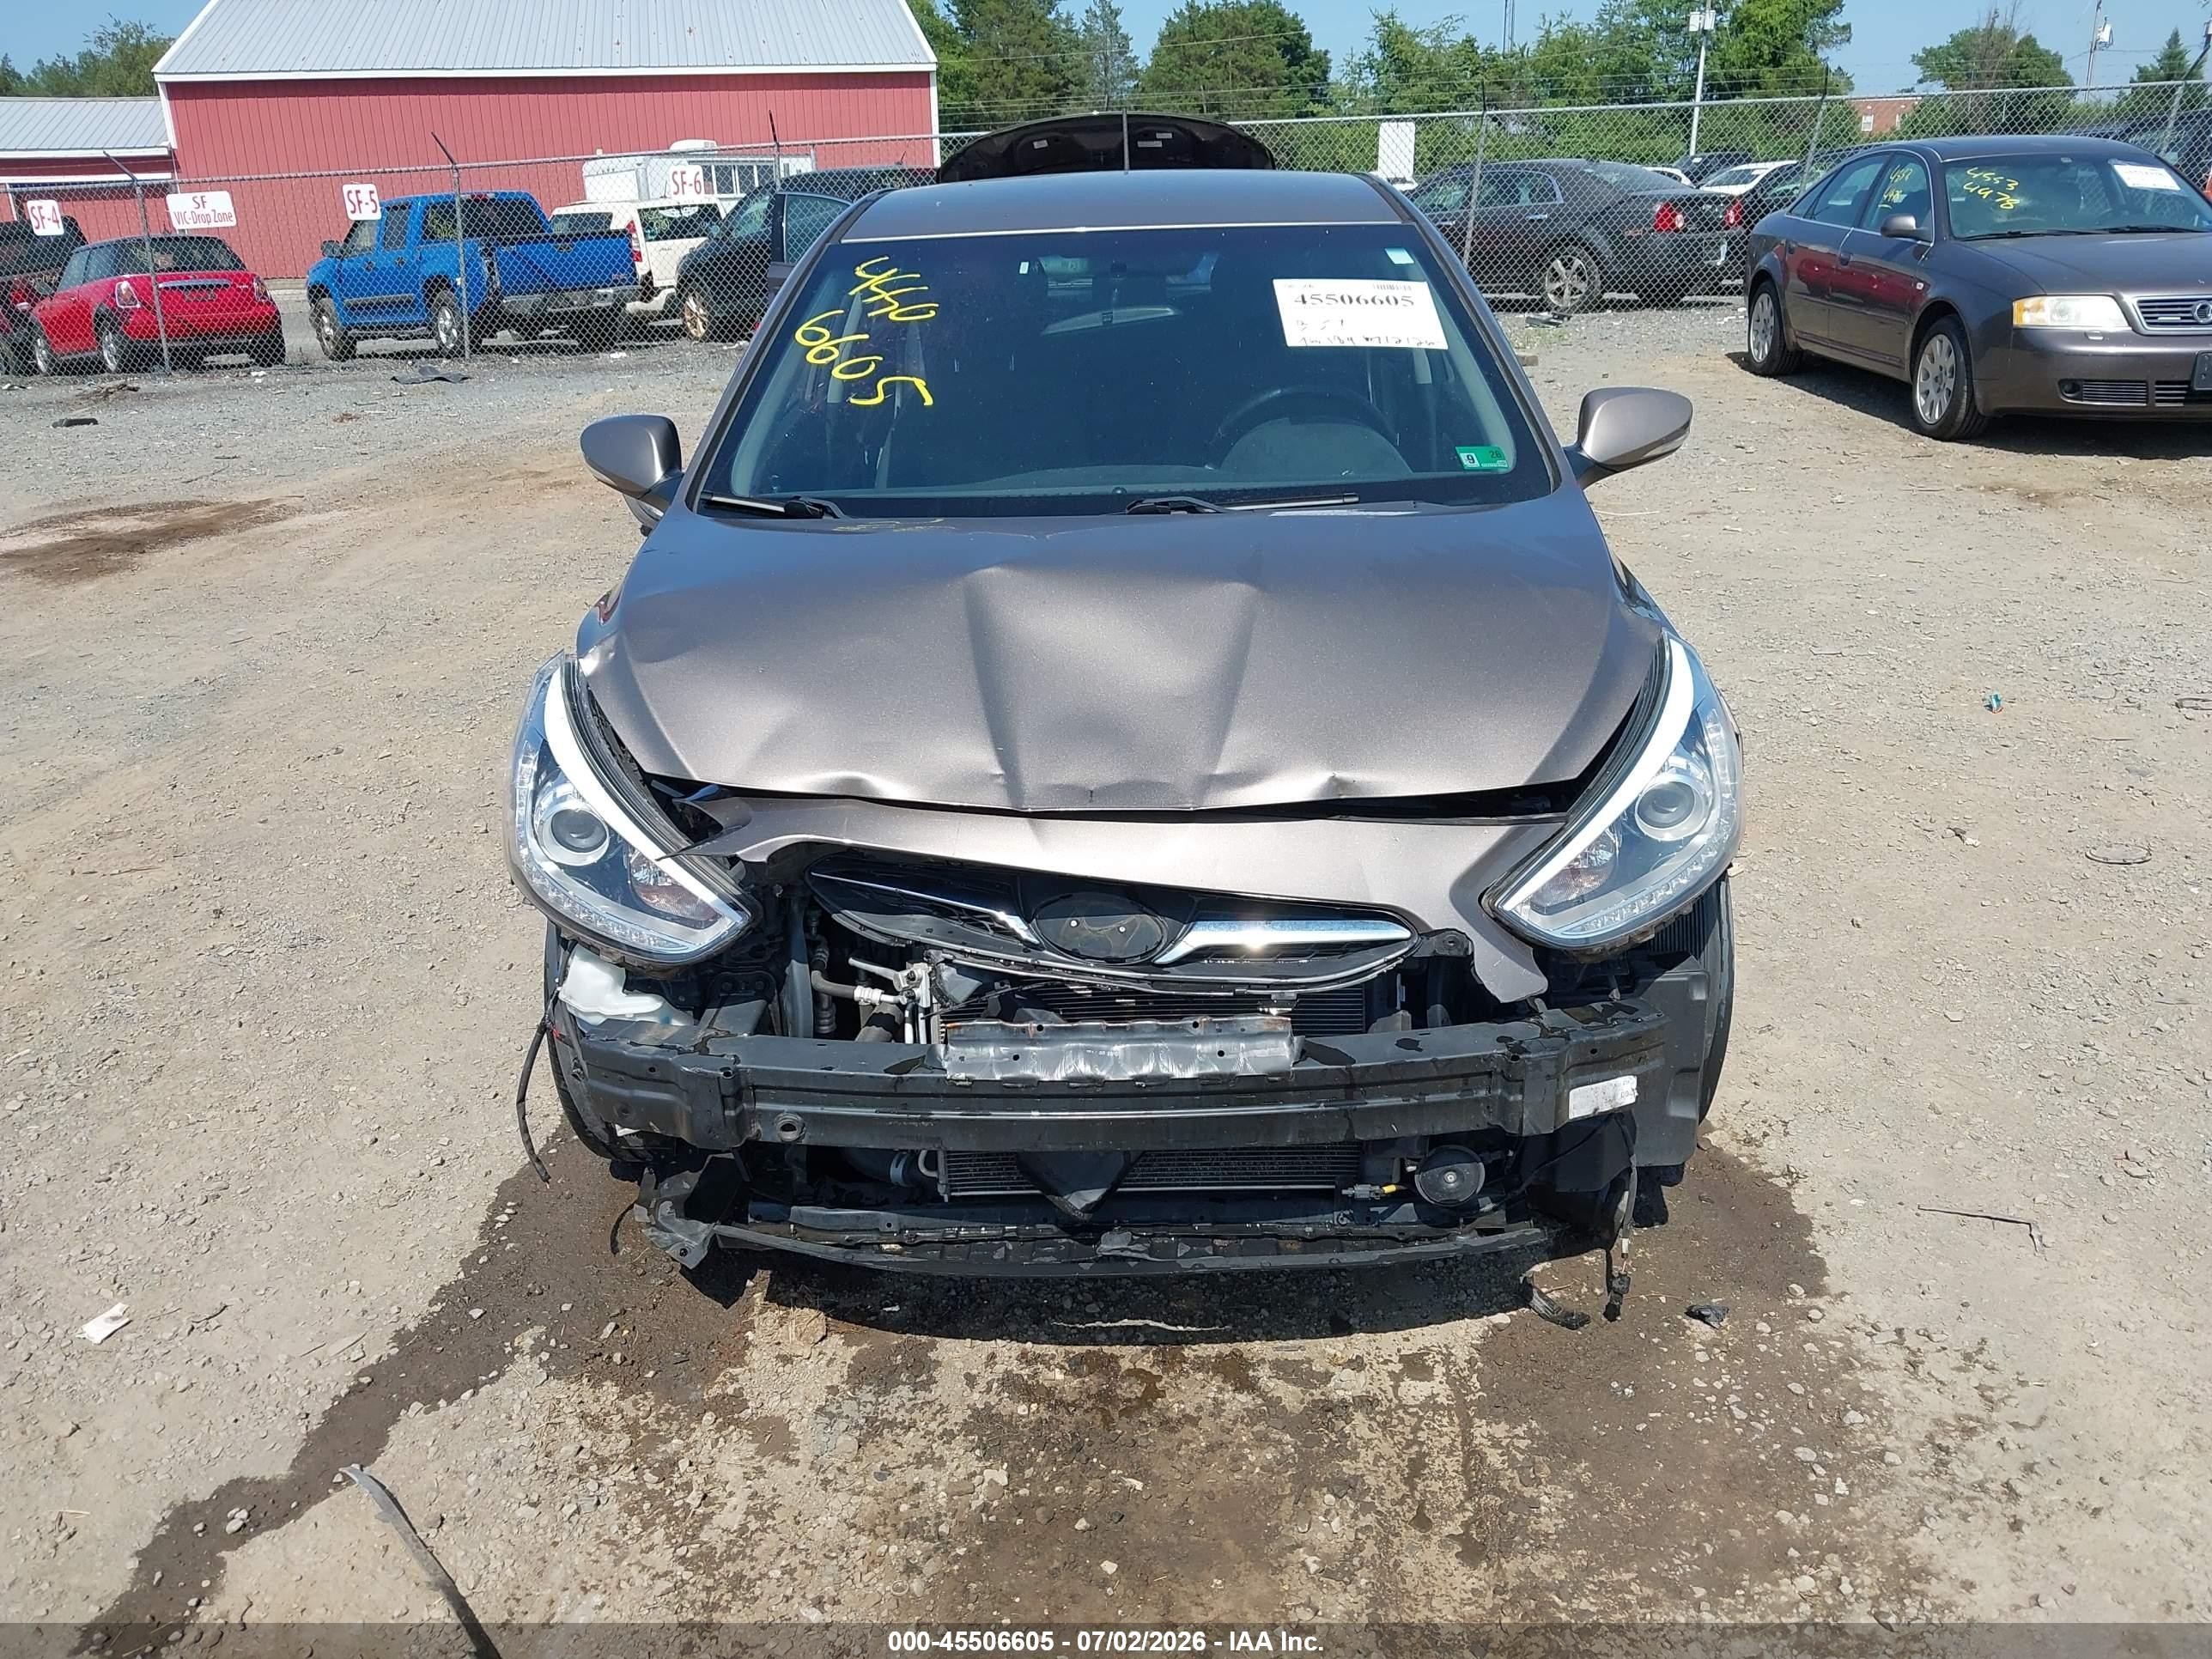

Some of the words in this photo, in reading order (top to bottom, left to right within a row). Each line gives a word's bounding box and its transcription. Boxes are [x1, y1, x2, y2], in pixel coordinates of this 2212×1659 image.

[672, 171, 702, 196] SF-6
[1966, 167, 2019, 191] 4553
[191, 195, 207, 210] SF
[346, 189, 378, 215] SF-5
[1963, 181, 2021, 210] 4478
[30, 205, 59, 230] SF-4
[173, 210, 211, 226] VIC-Drop
[211, 209, 233, 223] Zone
[1294, 293, 1415, 307] 45506605
[794, 309, 934, 406] 6605
[1466, 453, 1475, 465] 9
